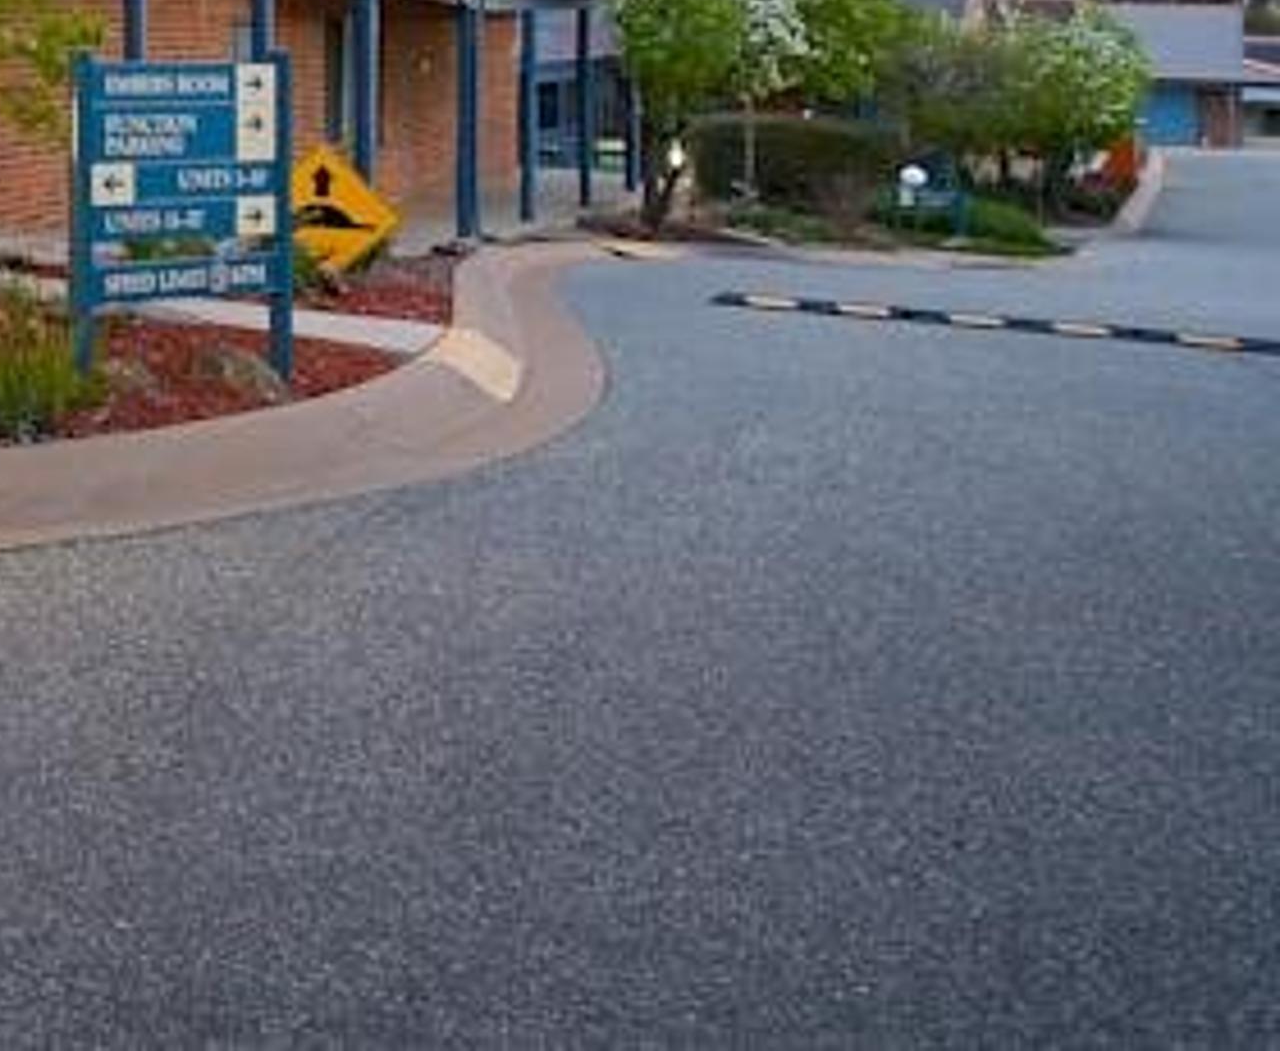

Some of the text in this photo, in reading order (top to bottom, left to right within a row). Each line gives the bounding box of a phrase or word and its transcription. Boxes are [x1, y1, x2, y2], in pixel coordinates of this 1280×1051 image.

[177, 71, 230, 95] ROOM
[104, 134, 185, 157] PARKING
[177, 167, 231, 190] UNITS
[104, 209, 161, 234] UNITS
[104, 271, 156, 296] SPEED
[158, 267, 208, 291] LIMIT
